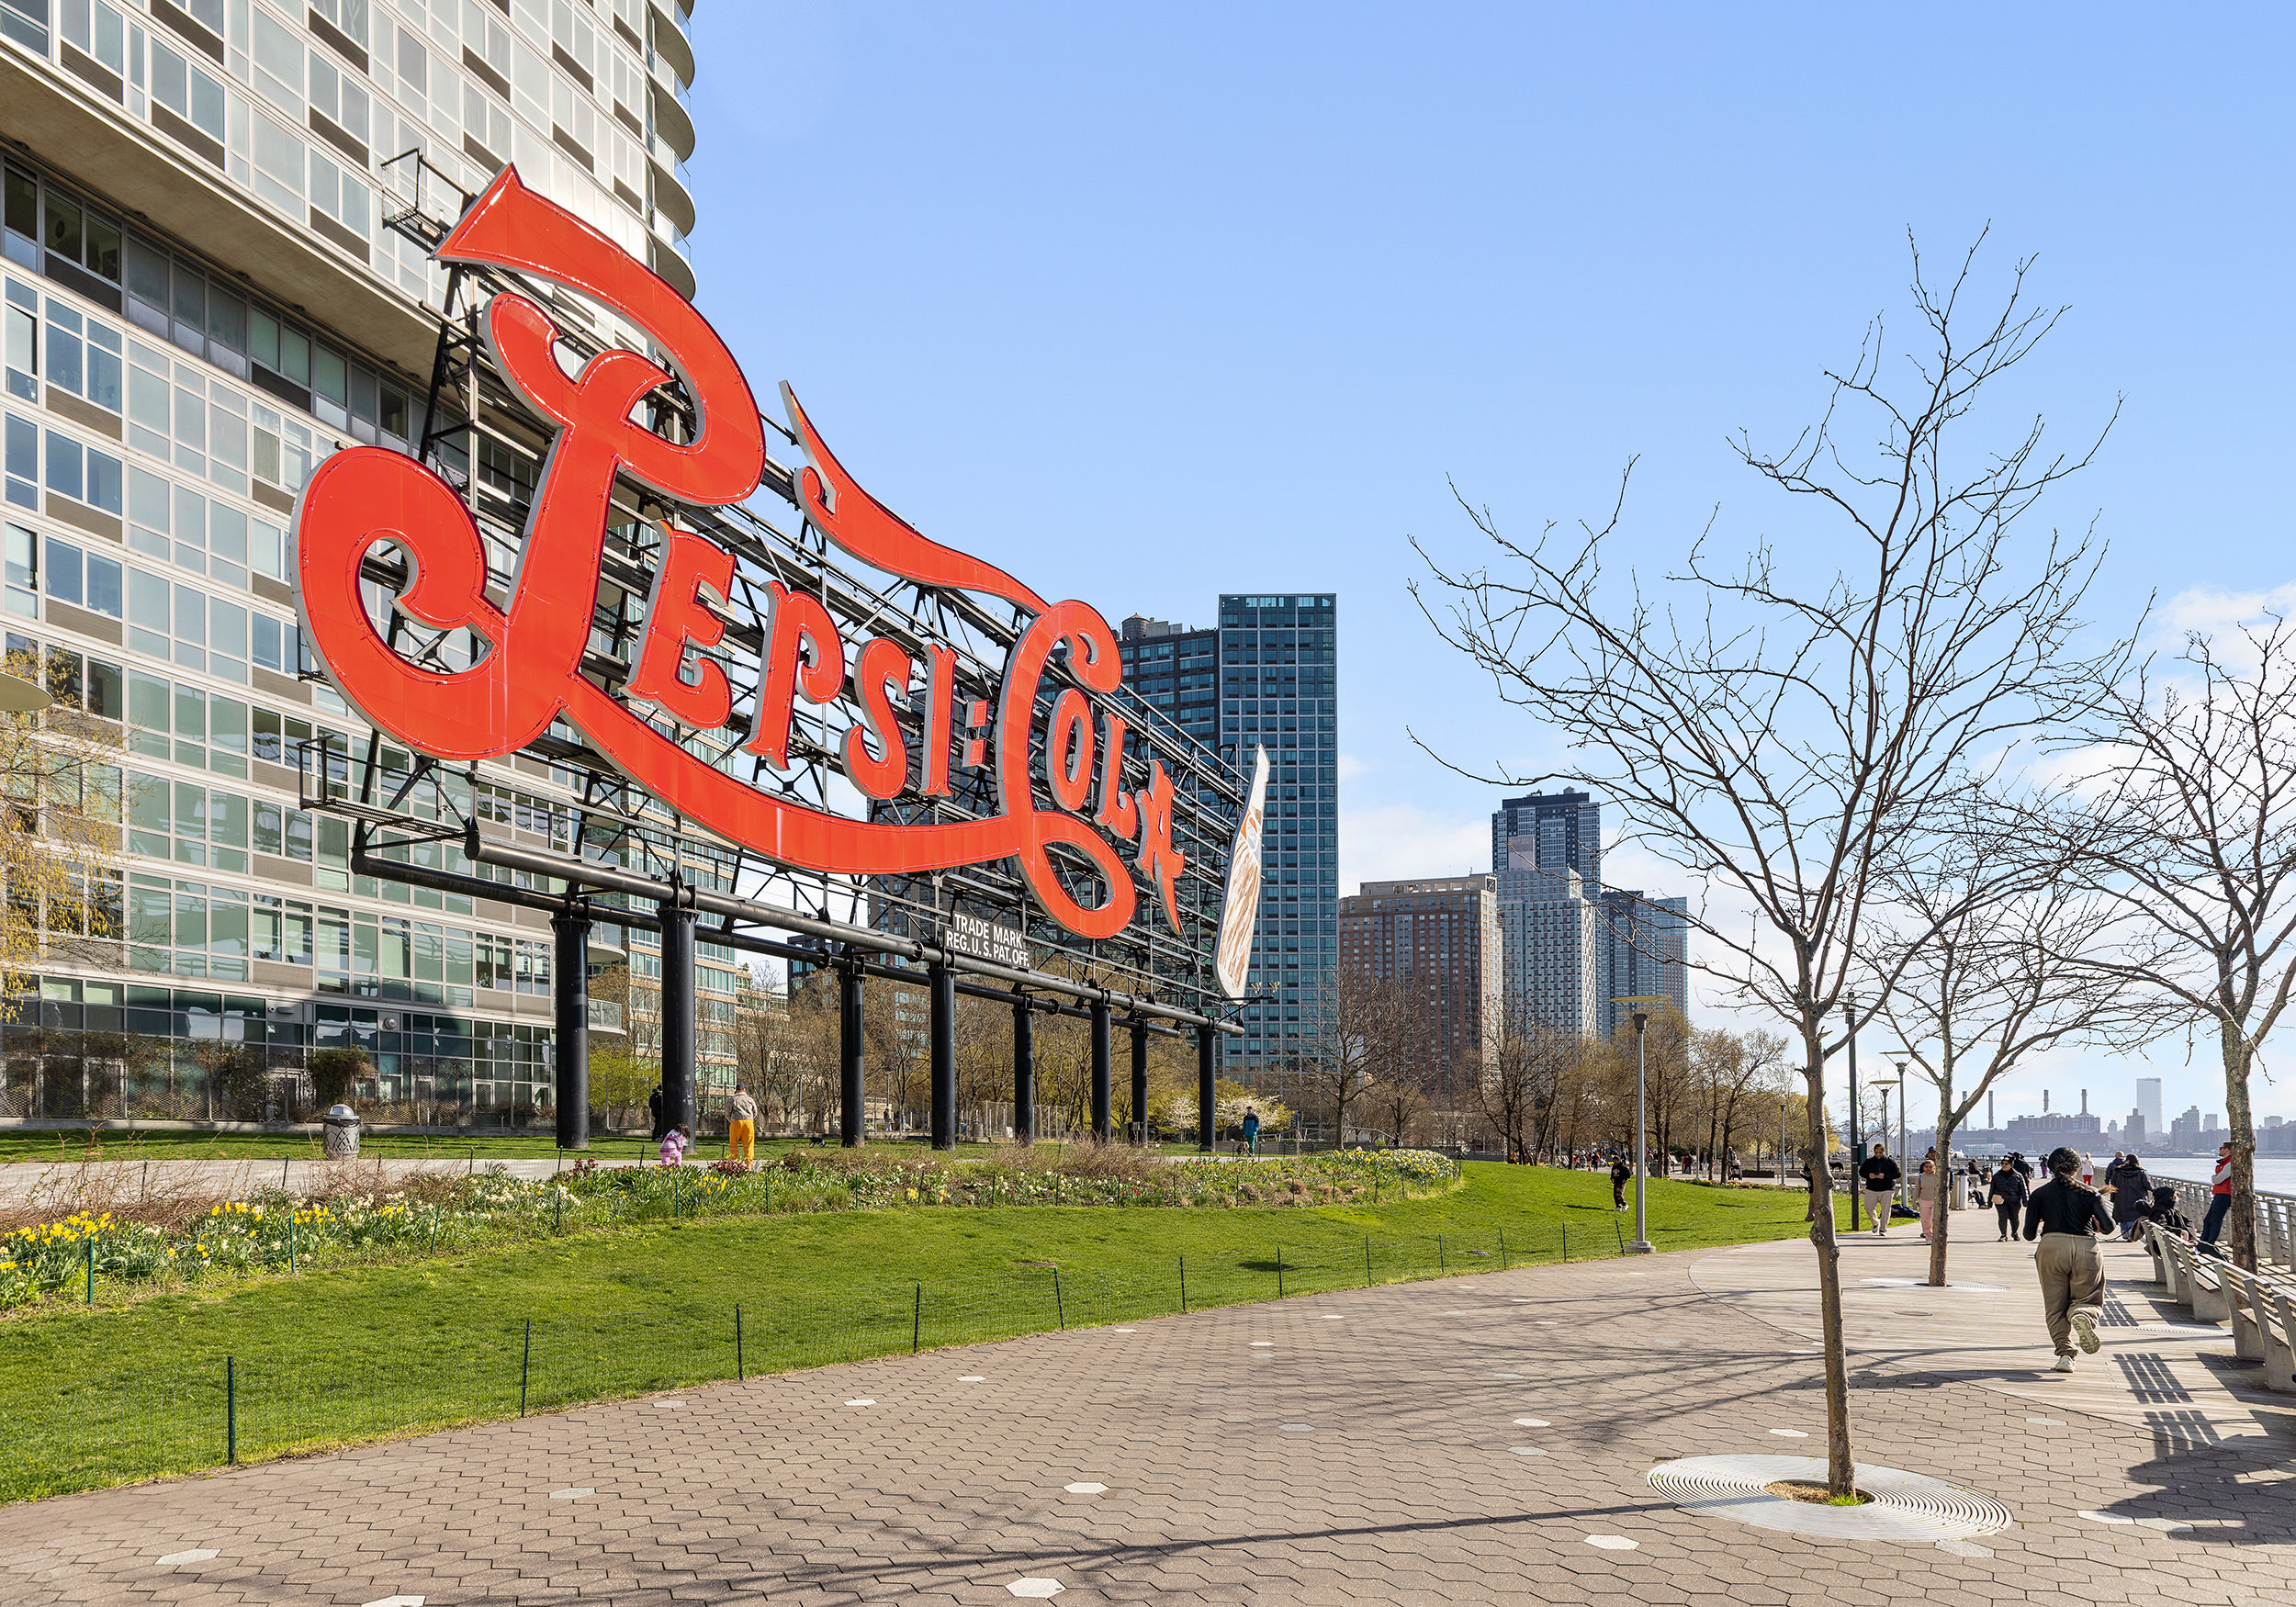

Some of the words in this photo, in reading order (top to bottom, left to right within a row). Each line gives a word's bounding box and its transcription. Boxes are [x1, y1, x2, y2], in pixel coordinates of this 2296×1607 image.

[946, 929, 971, 952] REG.
[993, 943, 1012, 962] PAT.
[1012, 949, 1030, 968] OFF.
[954, 913, 990, 939] TRADE
[993, 925, 1023, 949] MARK
